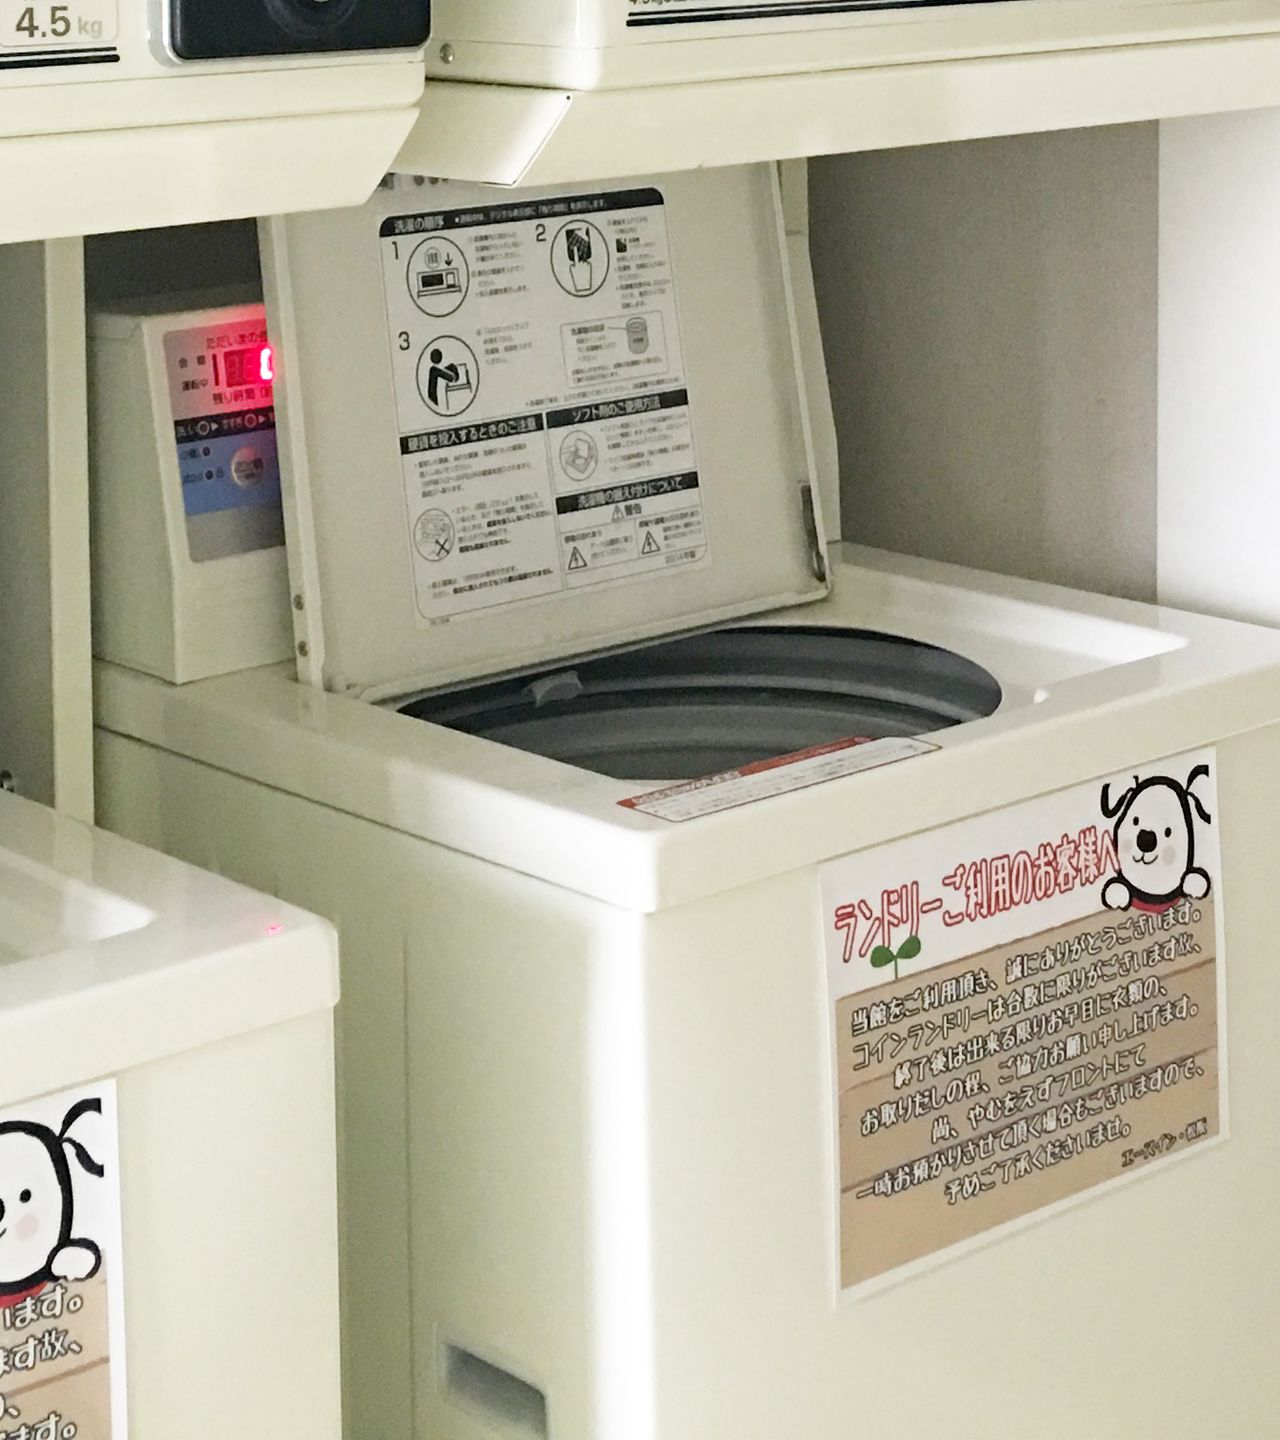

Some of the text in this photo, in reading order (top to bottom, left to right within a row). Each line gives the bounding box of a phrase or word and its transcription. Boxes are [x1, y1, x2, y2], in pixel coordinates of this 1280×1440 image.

[15, 6, 104, 38] 4.5 kg
[535, 224, 546, 242] 2
[392, 241, 399, 260] 1
[398, 331, 410, 351] 3
[835, 826, 1122, 963] ランドリーご利用のお客様へ
[931, 1044, 1147, 1144] 尚、やむをえずフロントにて
[944, 1120, 1131, 1206] 予めご了承くださいませ。
